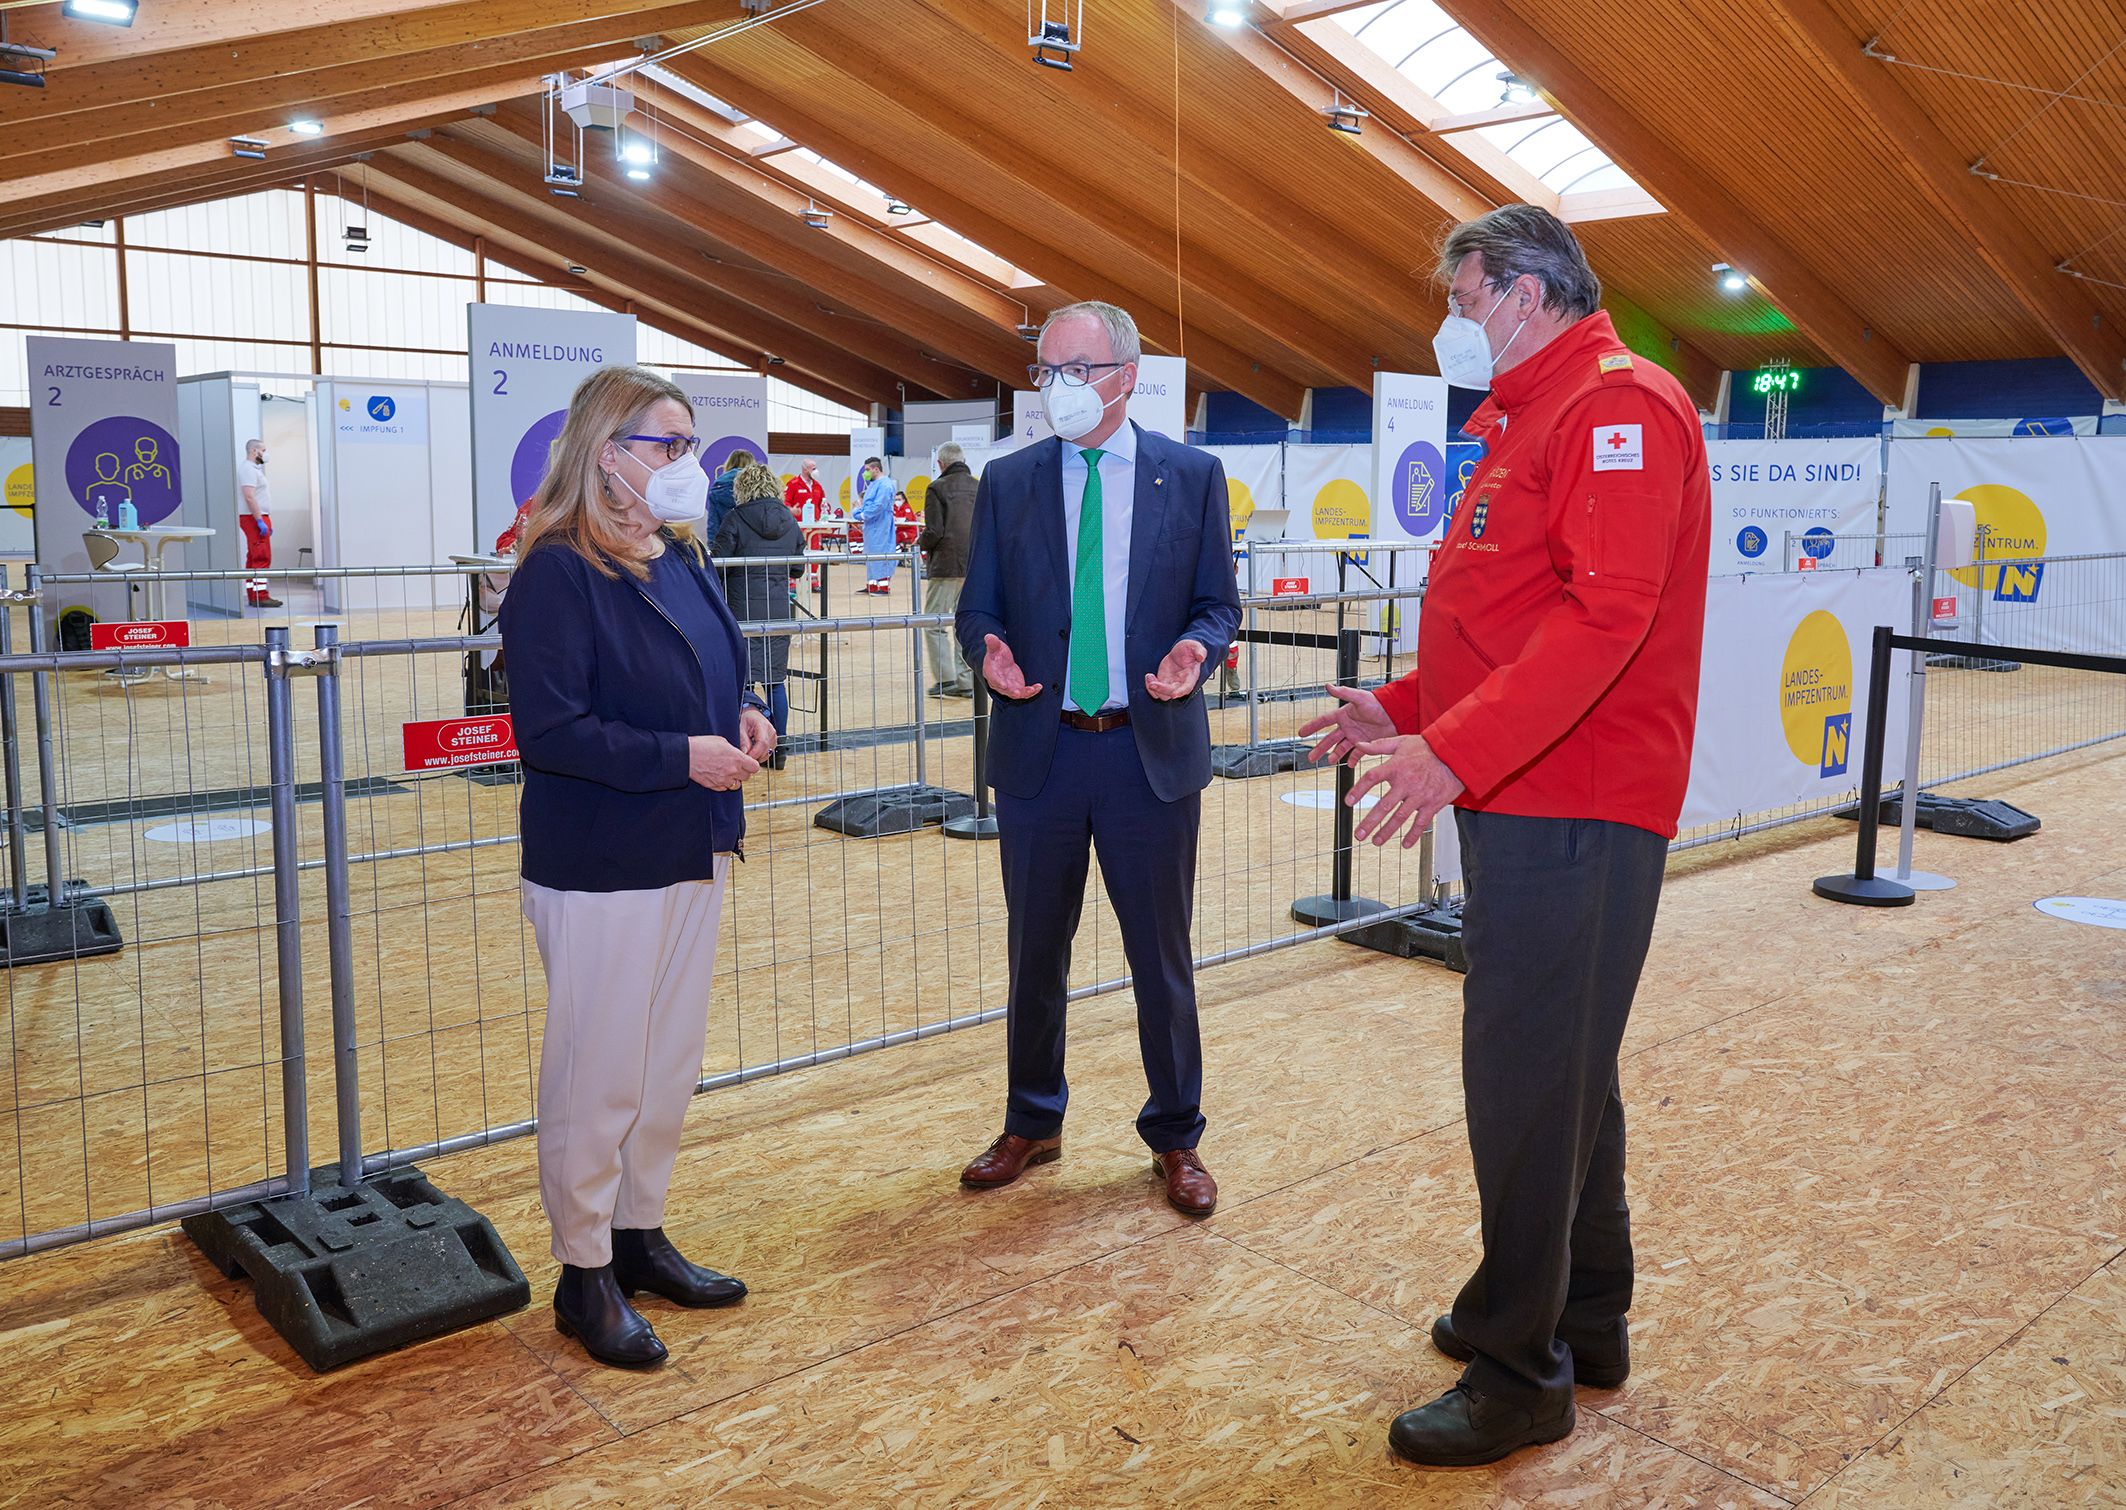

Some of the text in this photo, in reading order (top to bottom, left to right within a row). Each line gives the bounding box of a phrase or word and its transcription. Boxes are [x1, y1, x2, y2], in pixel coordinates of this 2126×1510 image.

[489, 341, 604, 363] ANMELDUNG
[44, 364, 164, 382] ARZTGESPRÄCH
[493, 369, 508, 396] 2
[48, 386, 62, 406] 2
[1387, 397, 1434, 411] ANMELDUNG
[360, 425, 397, 434] IMPFUNG
[1387, 416, 1395, 432] 4
[1026, 426, 1033, 439] 4
[1730, 464, 1759, 482] SIE
[1769, 464, 1797, 482] DA
[1805, 463, 1861, 482] SIND!
[1315, 507, 1347, 517] LANDES-
[1732, 508, 1840, 519] SO FUNKTIONIERT'S:
[1315, 517, 1368, 527] IMPFZENTRUM.
[123, 633, 158, 641] STEINER
[1785, 668, 1823, 687] LANDES-
[1784, 684, 1849, 707] IMPFZENTRUM.
[457, 725, 493, 736] JOSEF
[451, 734, 498, 746] STEINER
